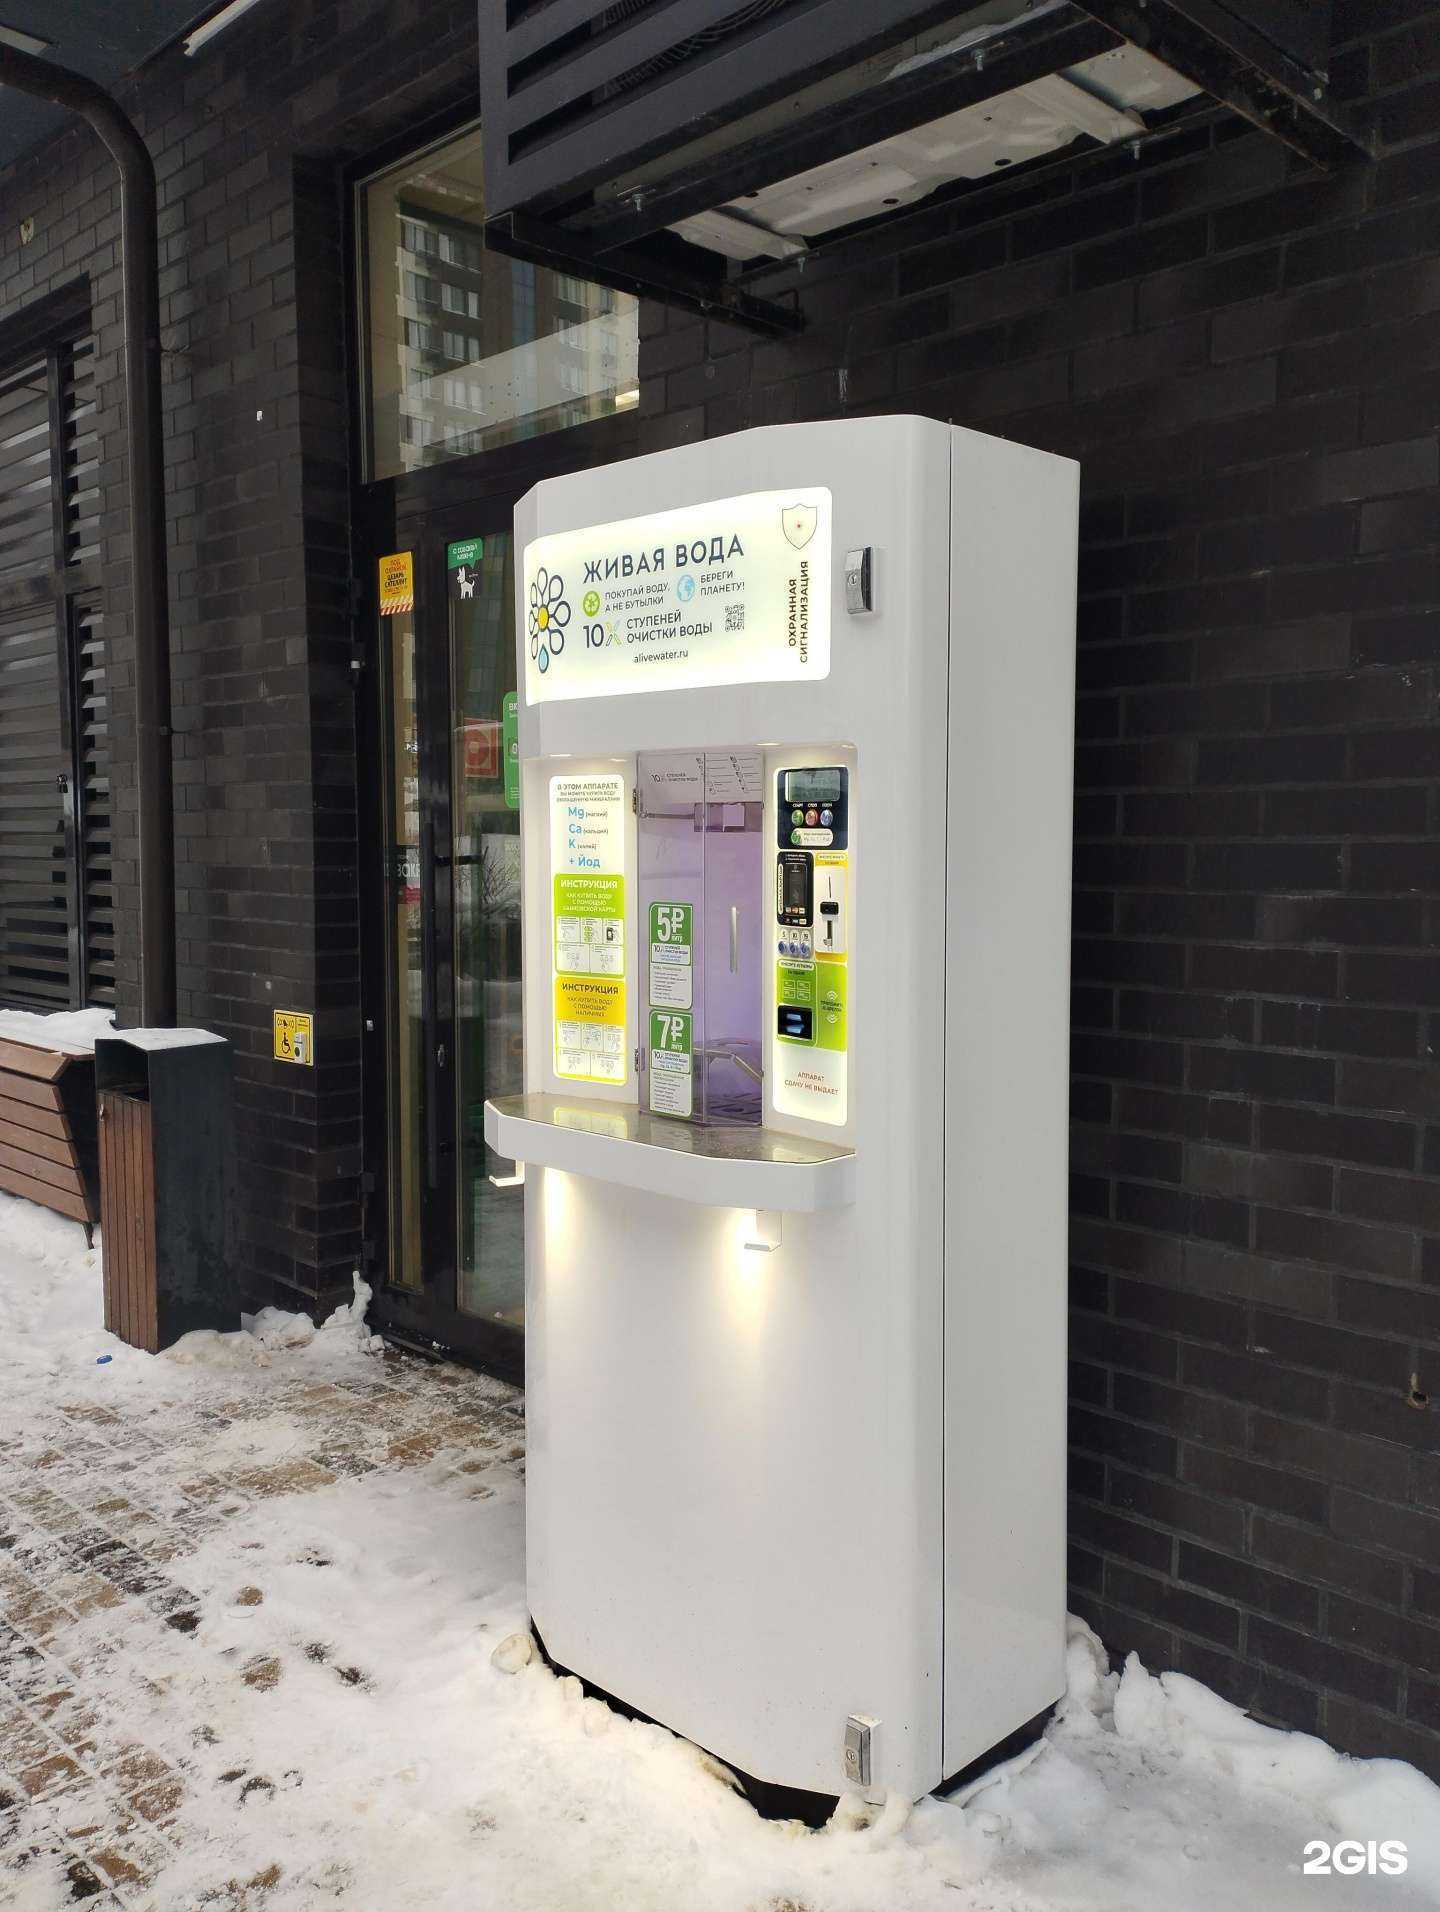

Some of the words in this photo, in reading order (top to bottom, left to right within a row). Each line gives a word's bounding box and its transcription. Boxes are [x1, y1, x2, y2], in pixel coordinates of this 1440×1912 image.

[583, 547, 665, 584] ЖИВАЯ
[676, 534, 744, 568] ВОДА
[700, 570, 734, 583] БЕРЕГИ
[605, 587, 645, 600] ПОКУПАЙ
[646, 582, 670, 597] ВОДУ,
[700, 581, 745, 596] ПЛАНЕТУ!
[613, 603, 623, 611] НЕ
[625, 596, 664, 610] БУТЫЛКИ
[627, 609, 681, 629] СТУПЕНЕЙ
[788, 578, 796, 647] ОХРАННАЯ
[800, 561, 809, 663] СИГНАЛИЗАЦИЯ
[583, 624, 604, 648] 10
[627, 627, 677, 643] ОЧИСТКИ
[679, 622, 712, 637] ВОДЫ
[634, 648, 688, 663] alivewater.ru
[568, 807, 584, 819] Mg
[578, 854, 600, 868] Йод
[560, 879, 618, 889] ИНСТРУКЦИЯ
[562, 983, 618, 994] ИНСТРУКЦИЯ
[798, 1071, 824, 1082] АППАРАТ
[814, 1084, 838, 1096] ВЫДАЕТ
